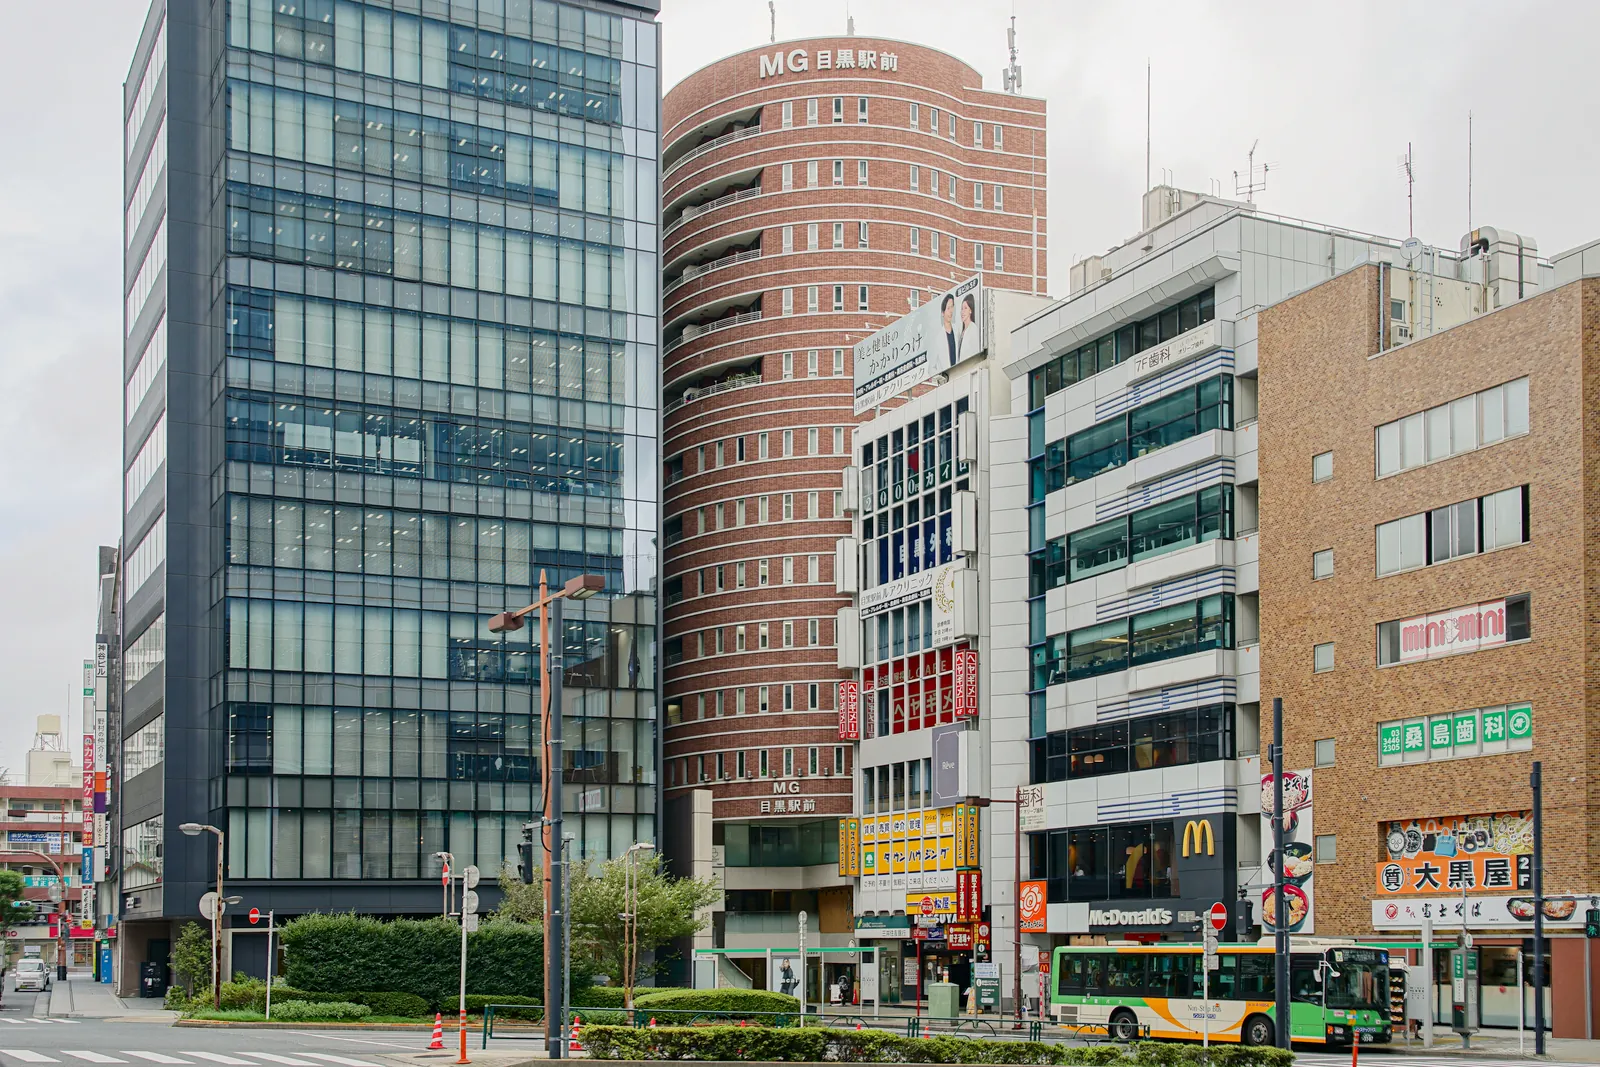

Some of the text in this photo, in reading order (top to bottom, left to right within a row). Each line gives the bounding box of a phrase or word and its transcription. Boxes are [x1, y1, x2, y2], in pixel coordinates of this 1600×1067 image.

[759, 49, 898, 78] MG 目黒駅前
[869, 334, 922, 375] かかりつけ
[968, 654, 976, 706] ヘヤギメ!
[849, 685, 857, 729] ヘヤギメ!
[1383, 737, 1400, 745] 3446
[1391, 729, 1400, 737] 03
[1405, 715, 1504, 749] 桑島歯科
[1383, 744, 1400, 752] 2305
[773, 781, 800, 794] MG
[1019, 786, 1044, 807] 歯科
[760, 799, 816, 813] 目黒駅前
[894, 821, 905, 832] 仲介
[884, 846, 950, 863] タウンハウジング
[1384, 868, 1401, 888] 質
[1413, 857, 1513, 891] 大黒屋
[1089, 908, 1173, 926] McDonald's
